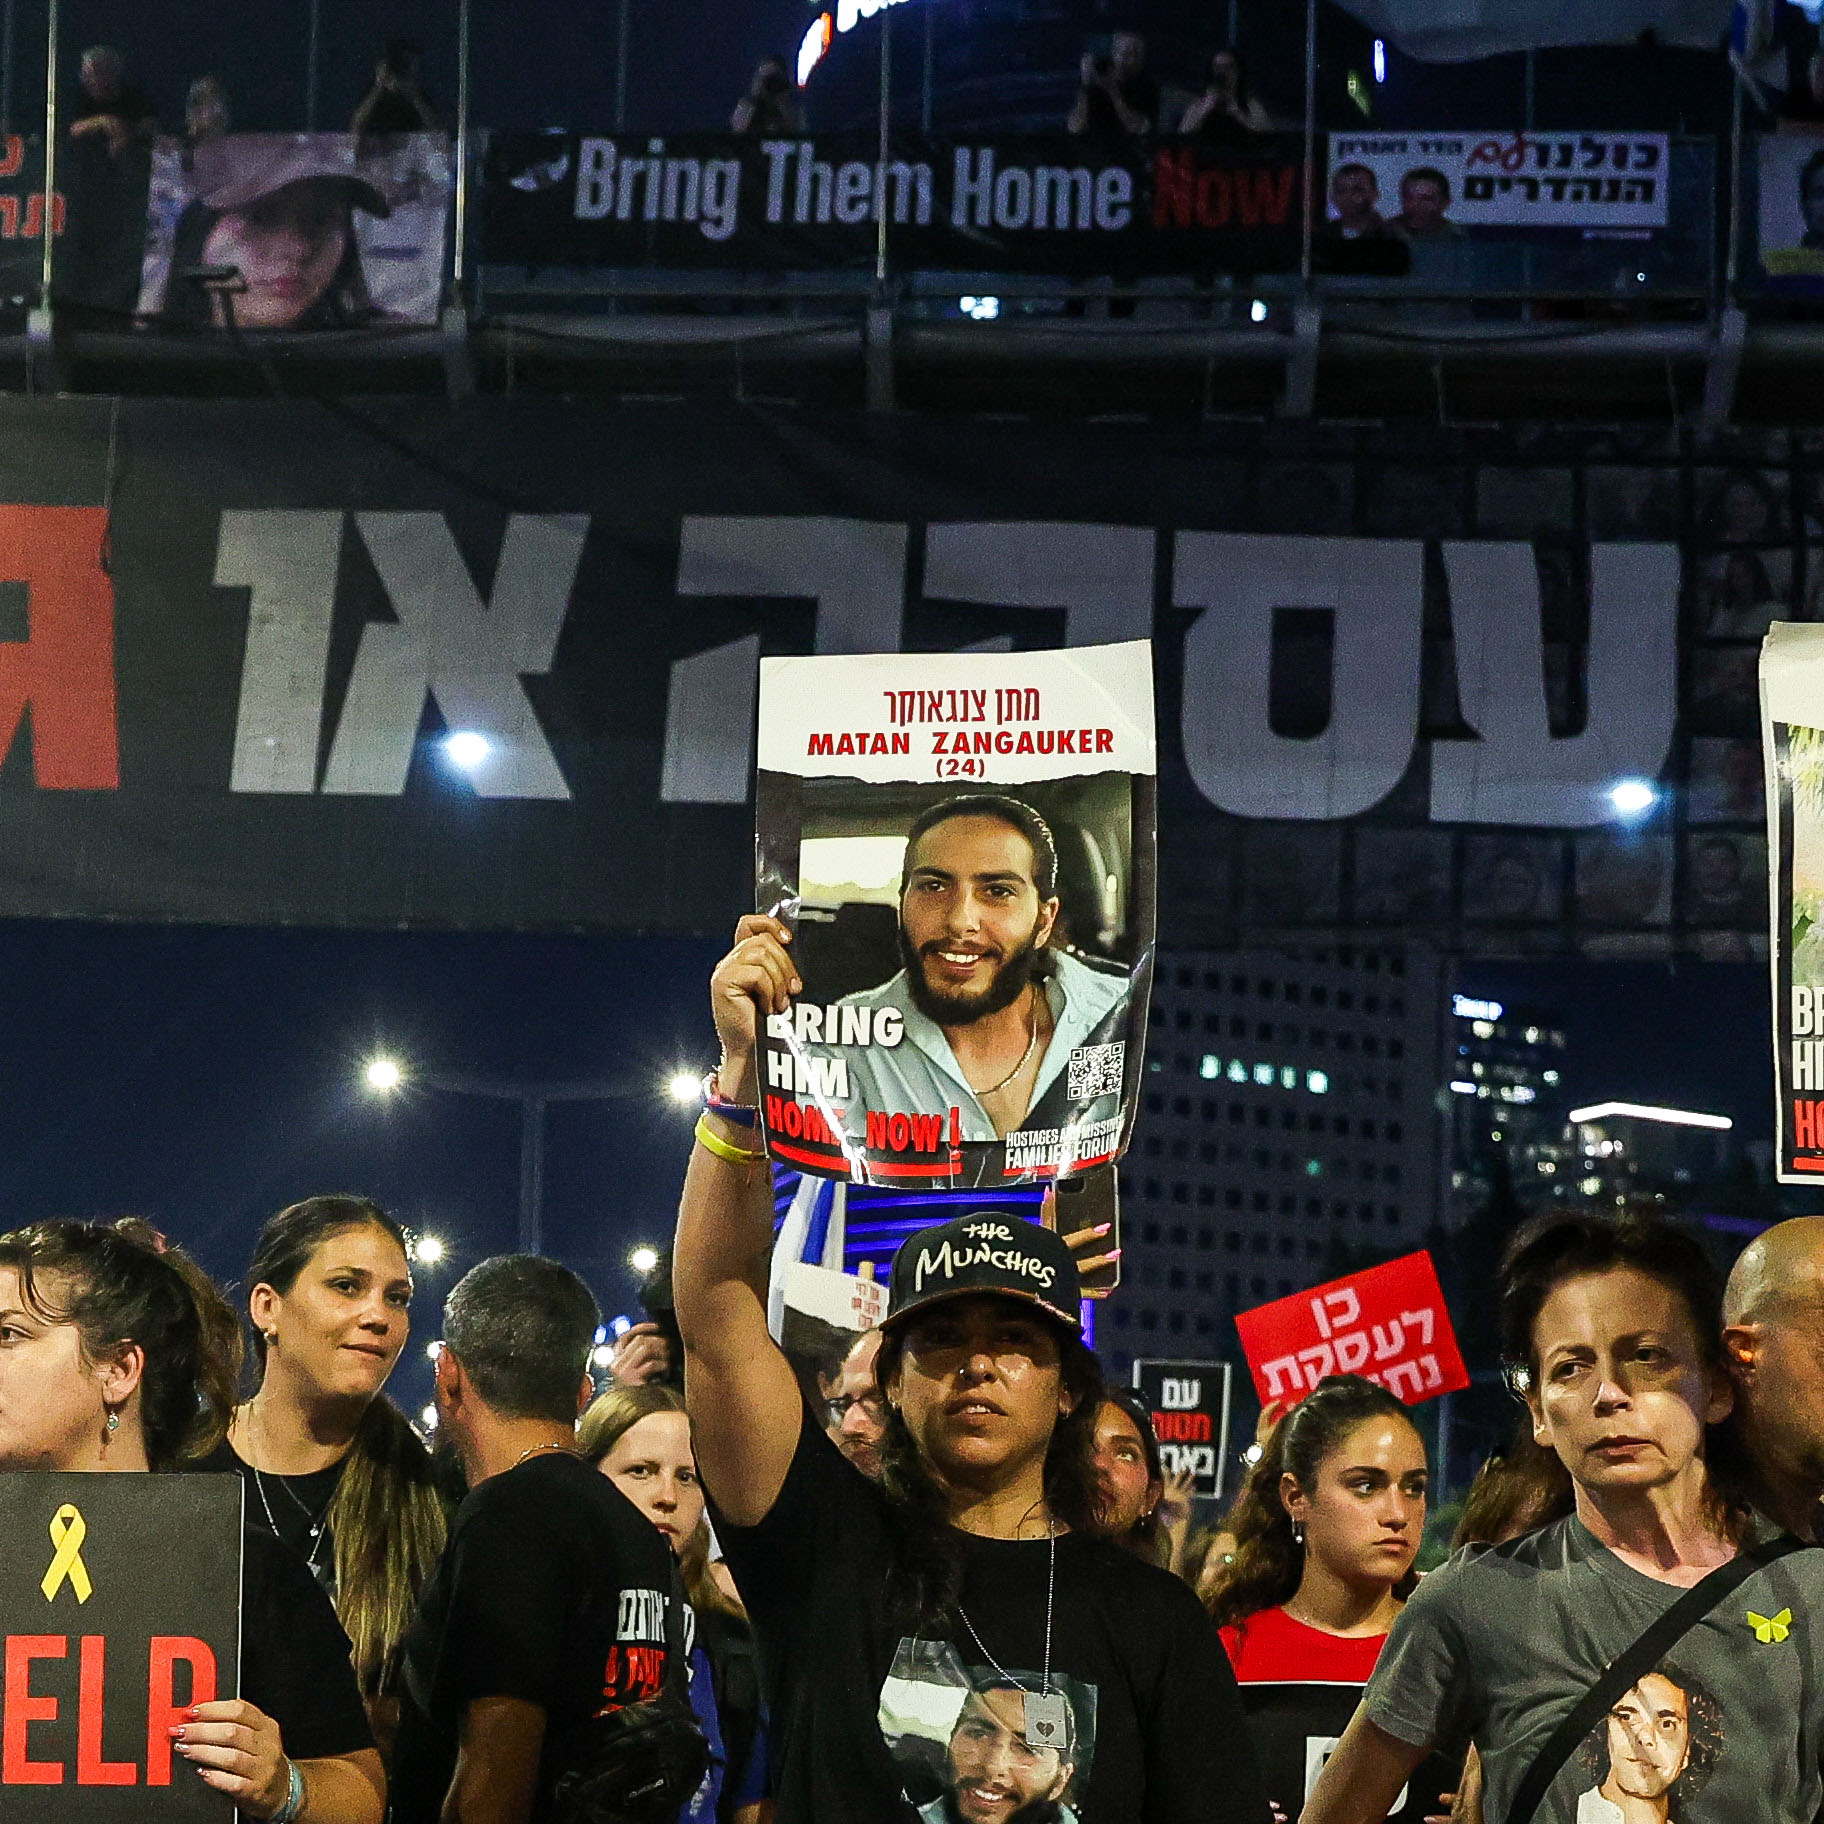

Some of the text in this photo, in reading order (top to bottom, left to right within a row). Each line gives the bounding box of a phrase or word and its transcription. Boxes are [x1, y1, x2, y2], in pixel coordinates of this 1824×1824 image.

[1533, 137, 1659, 171] כולנו
[574, 137, 1295, 241] Bring Them Home Now
[1463, 177, 1654, 201] הנהדרים
[213, 508, 591, 800] או
[882, 687, 1040, 727] מתן צנגאוקר
[806, 728, 1115, 756] MATAN ZANGAUKER
[935, 758, 986, 779] (24)
[766, 1049, 849, 1099] HIM
[766, 1093, 850, 1147] HOME
[1005, 1128, 1058, 1147] HOSTAGES
[1073, 1135, 1120, 1164] FORUM
[1310, 1286, 1362, 1338] כן
[1261, 1307, 1436, 1398] לעסקת
[1161, 1376, 1203, 1411] עם
